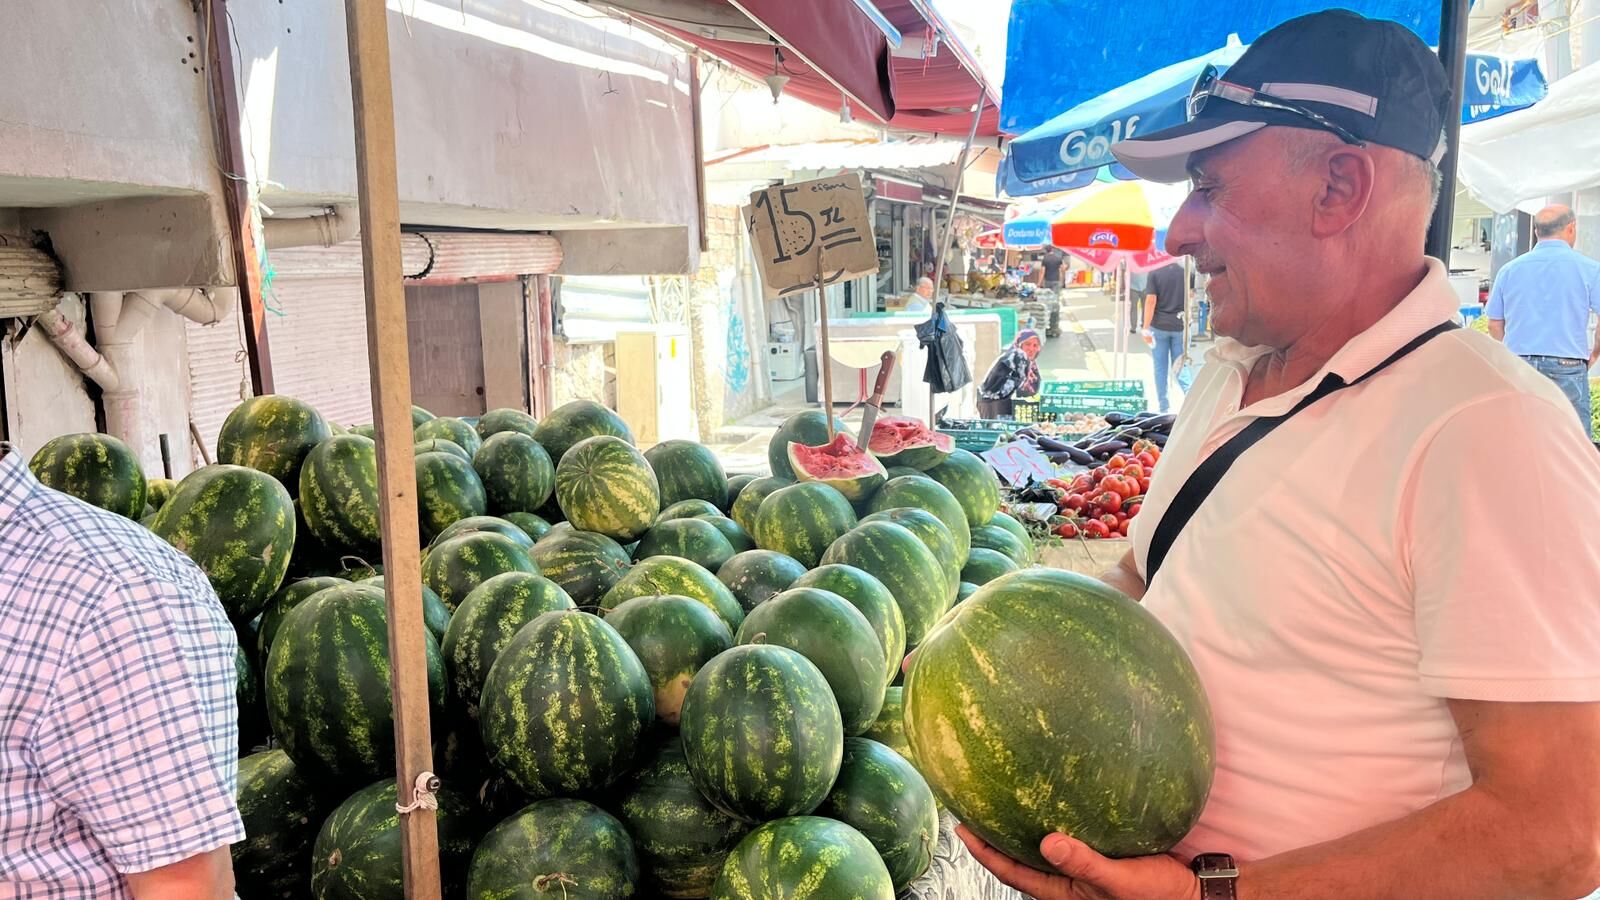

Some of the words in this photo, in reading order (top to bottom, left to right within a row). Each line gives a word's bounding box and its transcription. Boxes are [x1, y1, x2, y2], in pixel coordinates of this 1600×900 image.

[1475, 58, 1514, 99] Golf
[1059, 115, 1140, 165] Golf
[756, 187, 816, 263] 15
